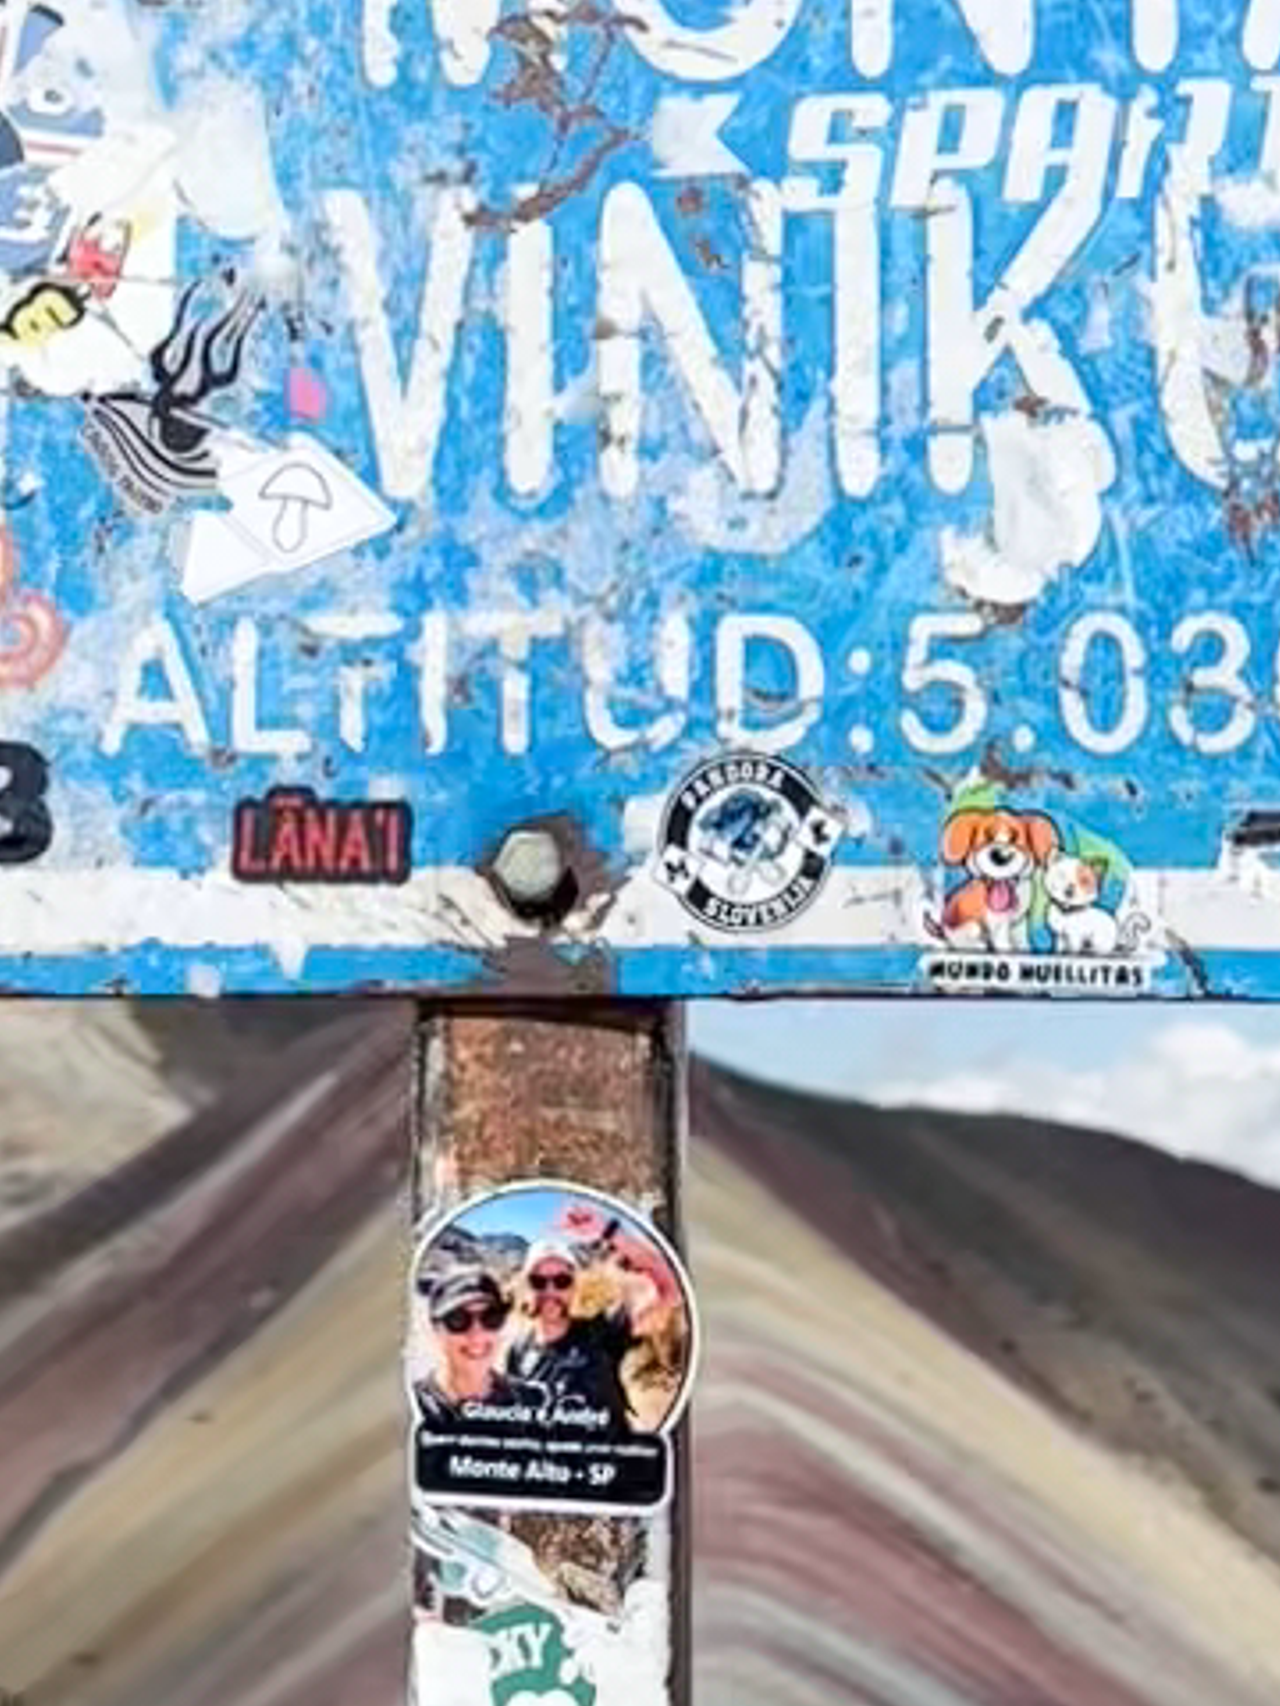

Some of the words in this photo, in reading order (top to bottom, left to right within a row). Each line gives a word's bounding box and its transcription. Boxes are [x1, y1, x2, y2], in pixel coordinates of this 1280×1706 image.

[681, 762, 784, 809] PANDORA
[929, 959, 1011, 982] MUNDO
[449, 1455, 521, 1479] Monte
[526, 1460, 570, 1482] Alto
[588, 1463, 615, 1485] SP
